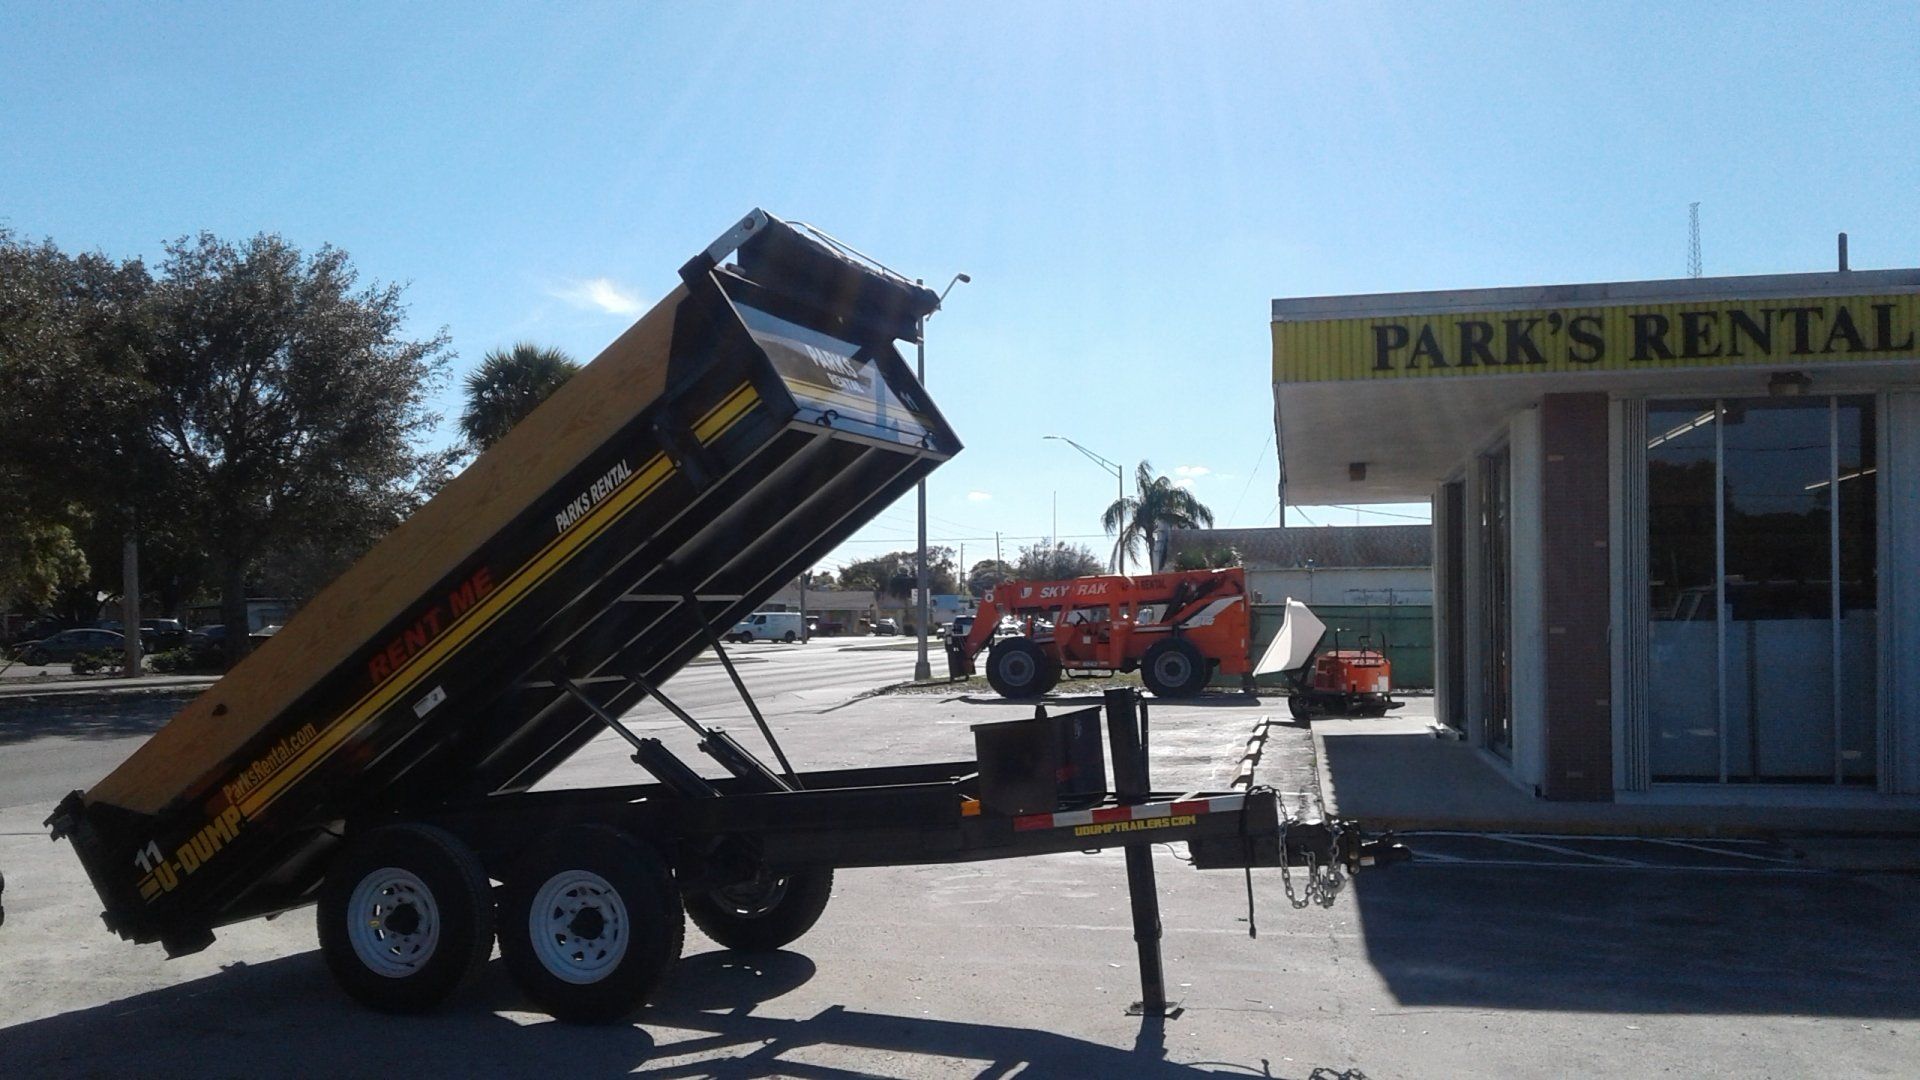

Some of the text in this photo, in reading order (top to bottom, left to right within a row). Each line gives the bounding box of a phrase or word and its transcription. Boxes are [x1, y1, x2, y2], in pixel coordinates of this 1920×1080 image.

[805, 344, 858, 378] PARKS
[1371, 304, 1915, 371] PARK'S RENTAL
[555, 459, 632, 532] PARKS RENTAL
[368, 566, 494, 683] RENT ME
[222, 722, 317, 804] ParksRental.com
[135, 840, 164, 873] 11
[153, 805, 242, 892] U-DUMP
[1075, 815, 1196, 836] UDUMPTRAILERSCOM
